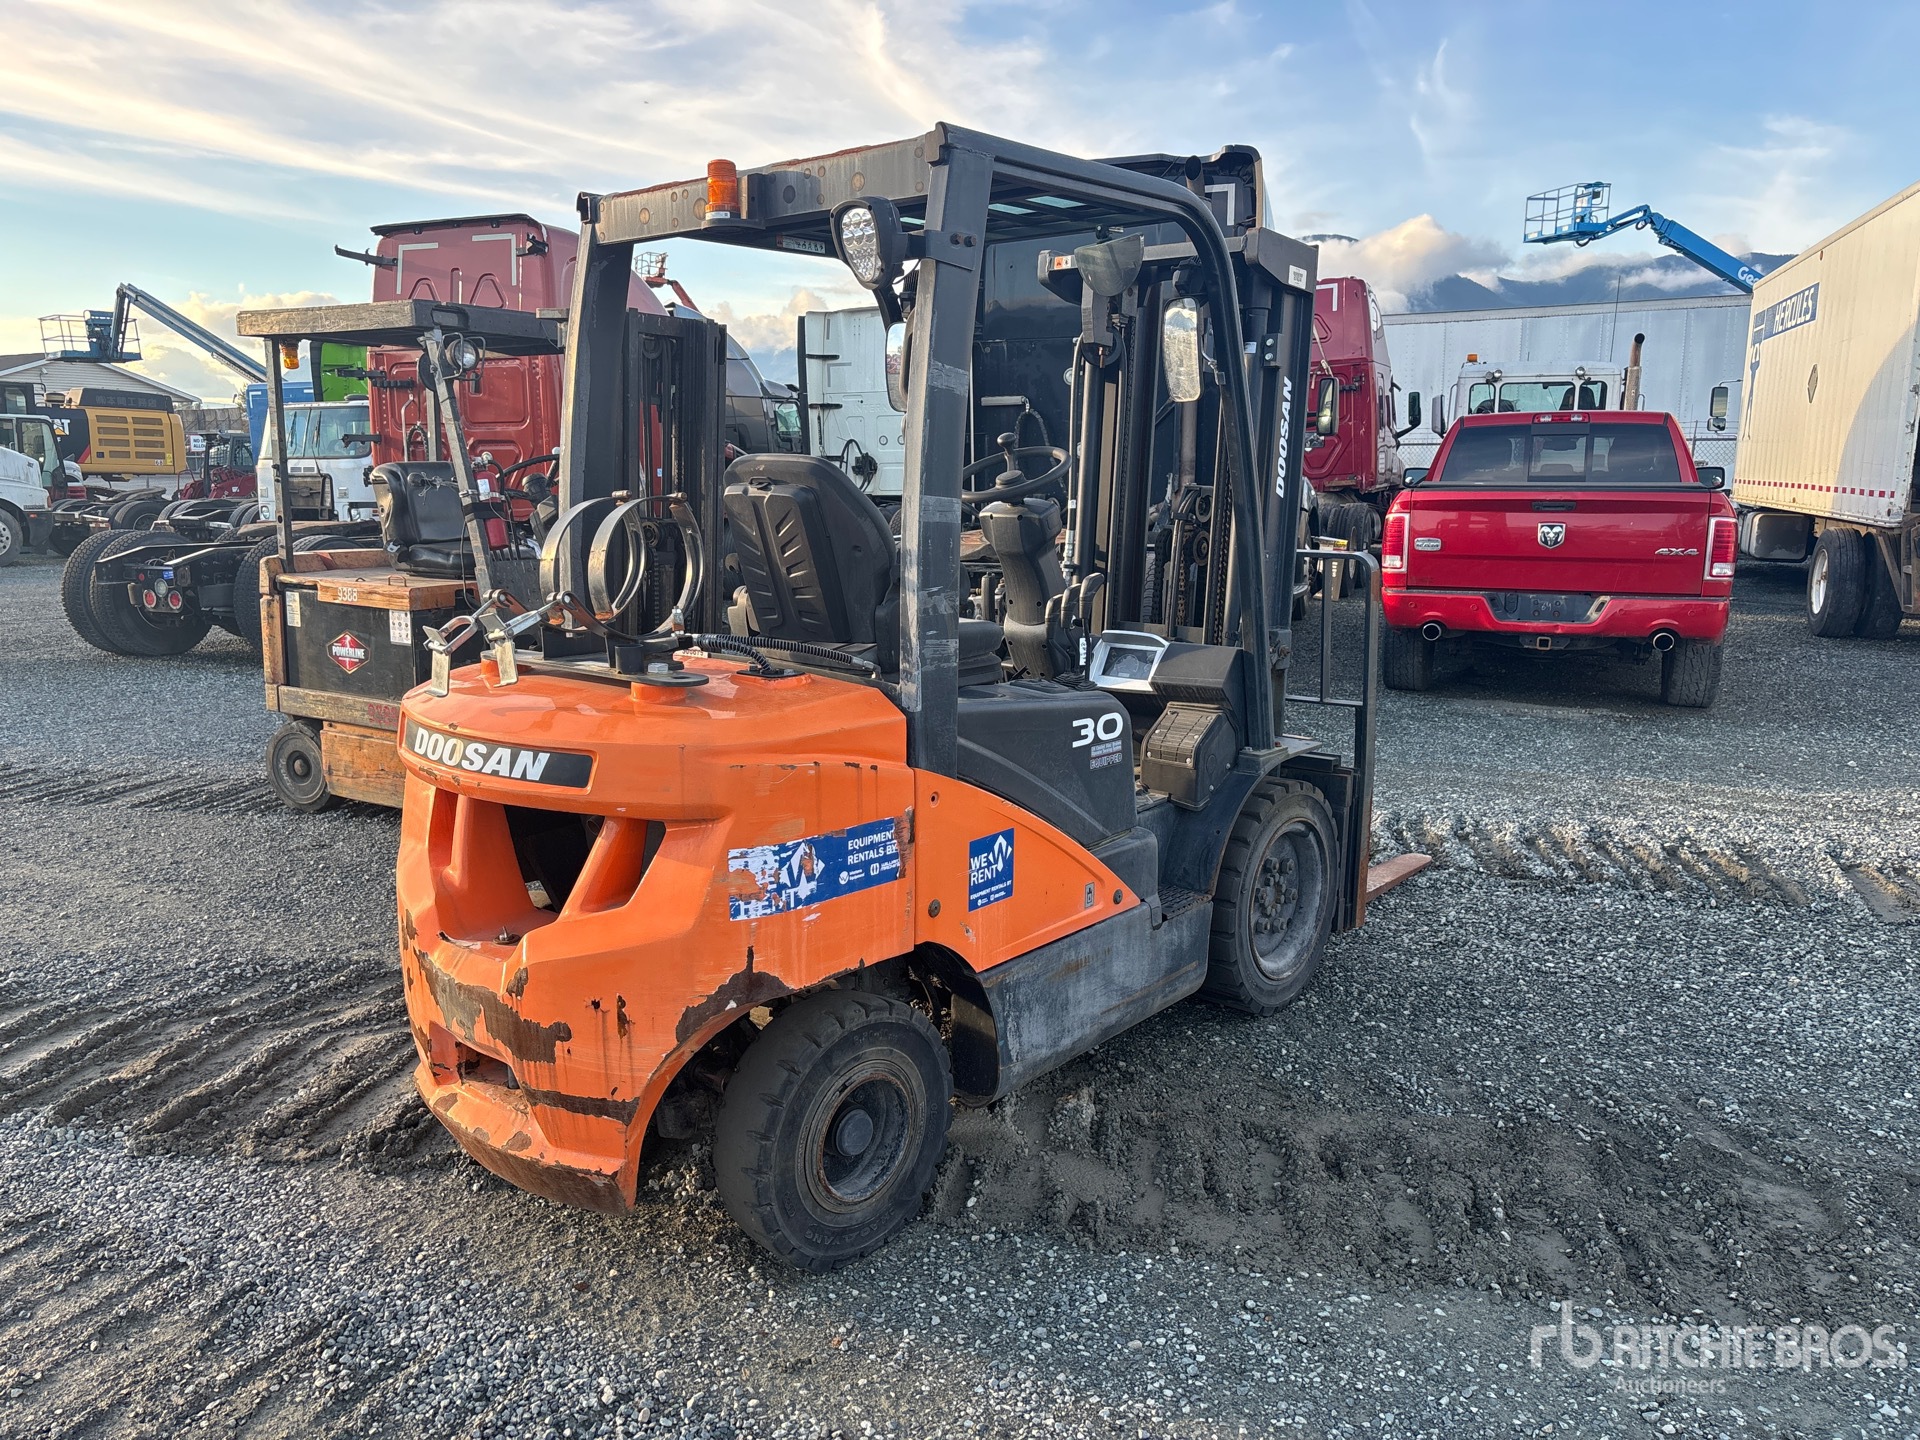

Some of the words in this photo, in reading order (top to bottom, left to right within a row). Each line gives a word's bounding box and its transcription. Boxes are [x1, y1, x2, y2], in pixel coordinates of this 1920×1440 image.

[1772, 287, 1815, 334] HERCULES
[1276, 376, 1293, 498] DOOSAN
[337, 587, 358, 601] 9388
[332, 646, 365, 659] POWERLINE
[1072, 712, 1124, 748] 30
[414, 727, 550, 781] DOOSAN
[847, 830, 895, 851] EQUIPMENT
[847, 847, 885, 866] RENTALS
[886, 843, 898, 855] BY
[970, 853, 988, 871] WE
[970, 864, 998, 887] RENT
